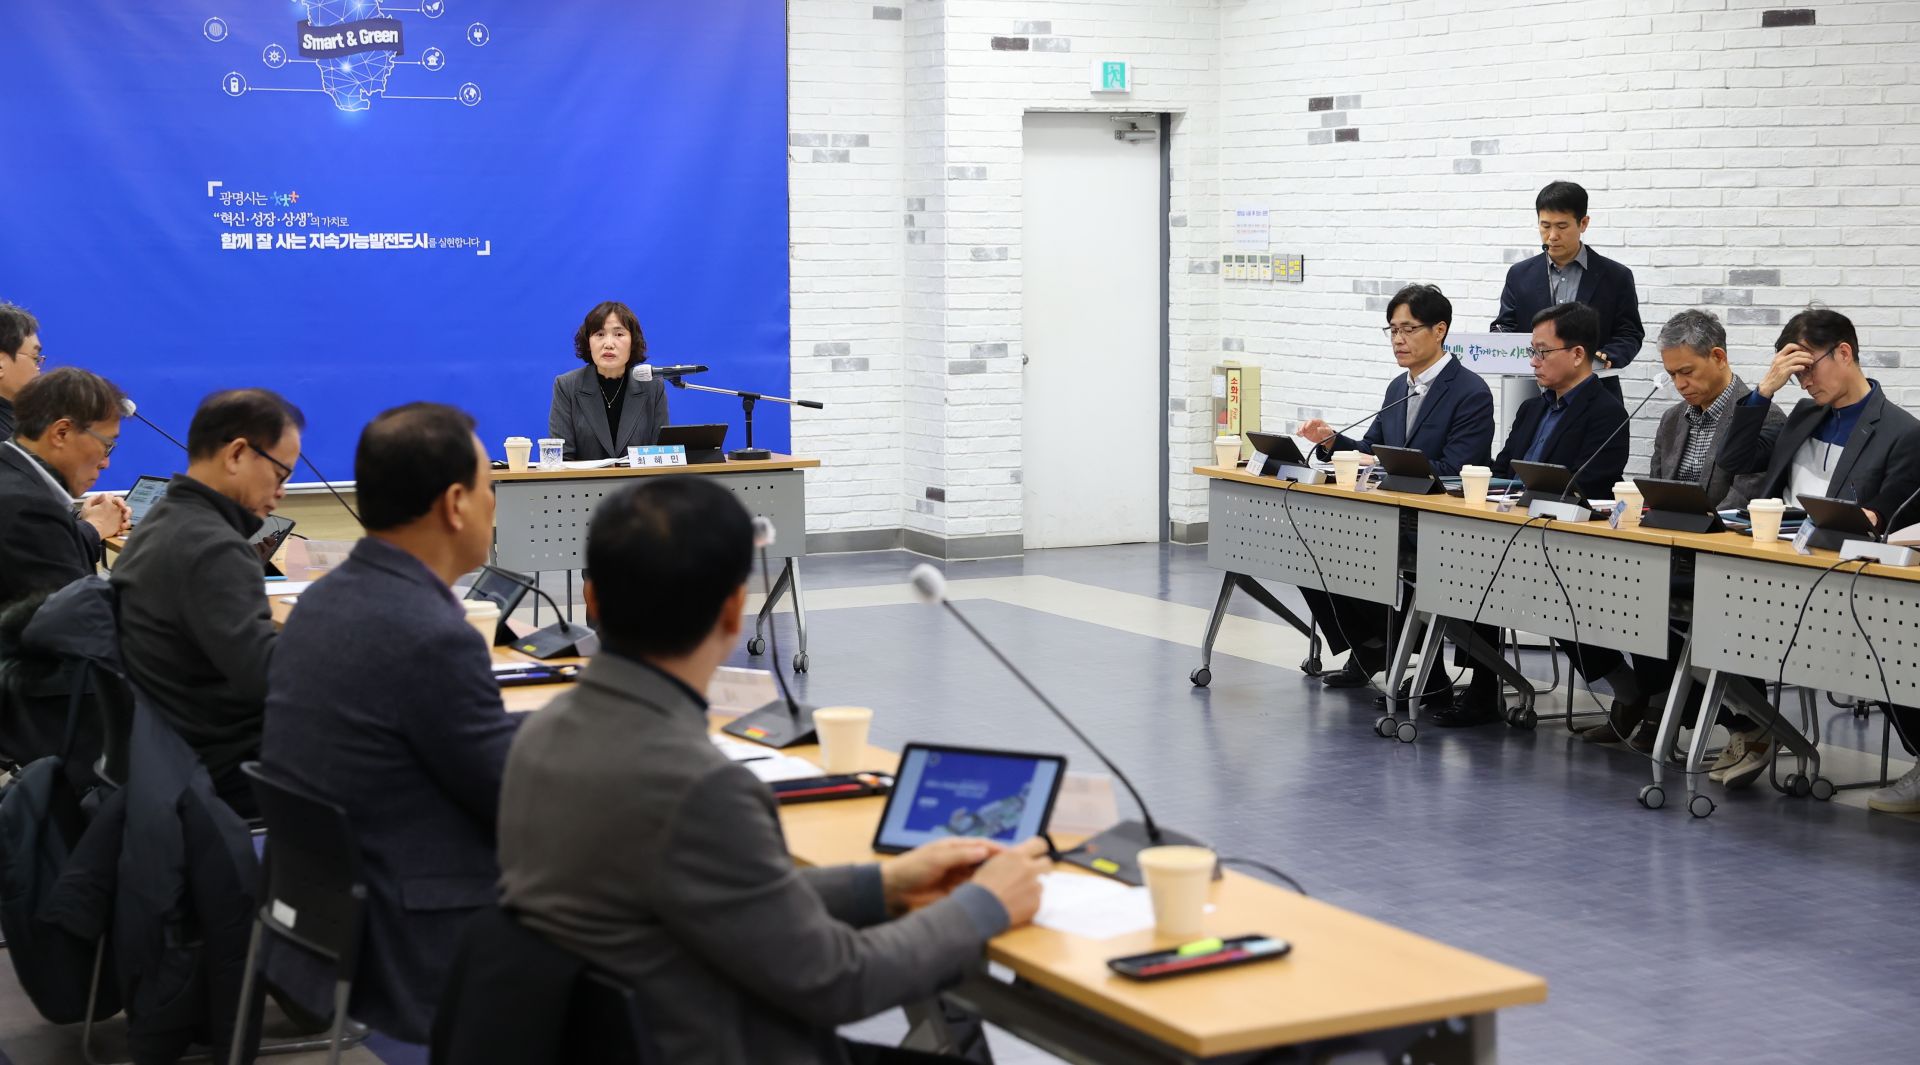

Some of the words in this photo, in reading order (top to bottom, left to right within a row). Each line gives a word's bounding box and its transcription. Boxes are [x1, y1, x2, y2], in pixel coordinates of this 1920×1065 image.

[302, 33, 345, 50] Smart
[346, 31, 358, 47] &
[359, 29, 398, 45] Green
[219, 191, 269, 206] 광명시는
[321, 216, 350, 227] 가치로
[221, 233, 253, 249] 함께
[255, 233, 273, 249] 잘
[275, 233, 307, 249] 사는
[438, 237, 480, 248] 실현합니다
